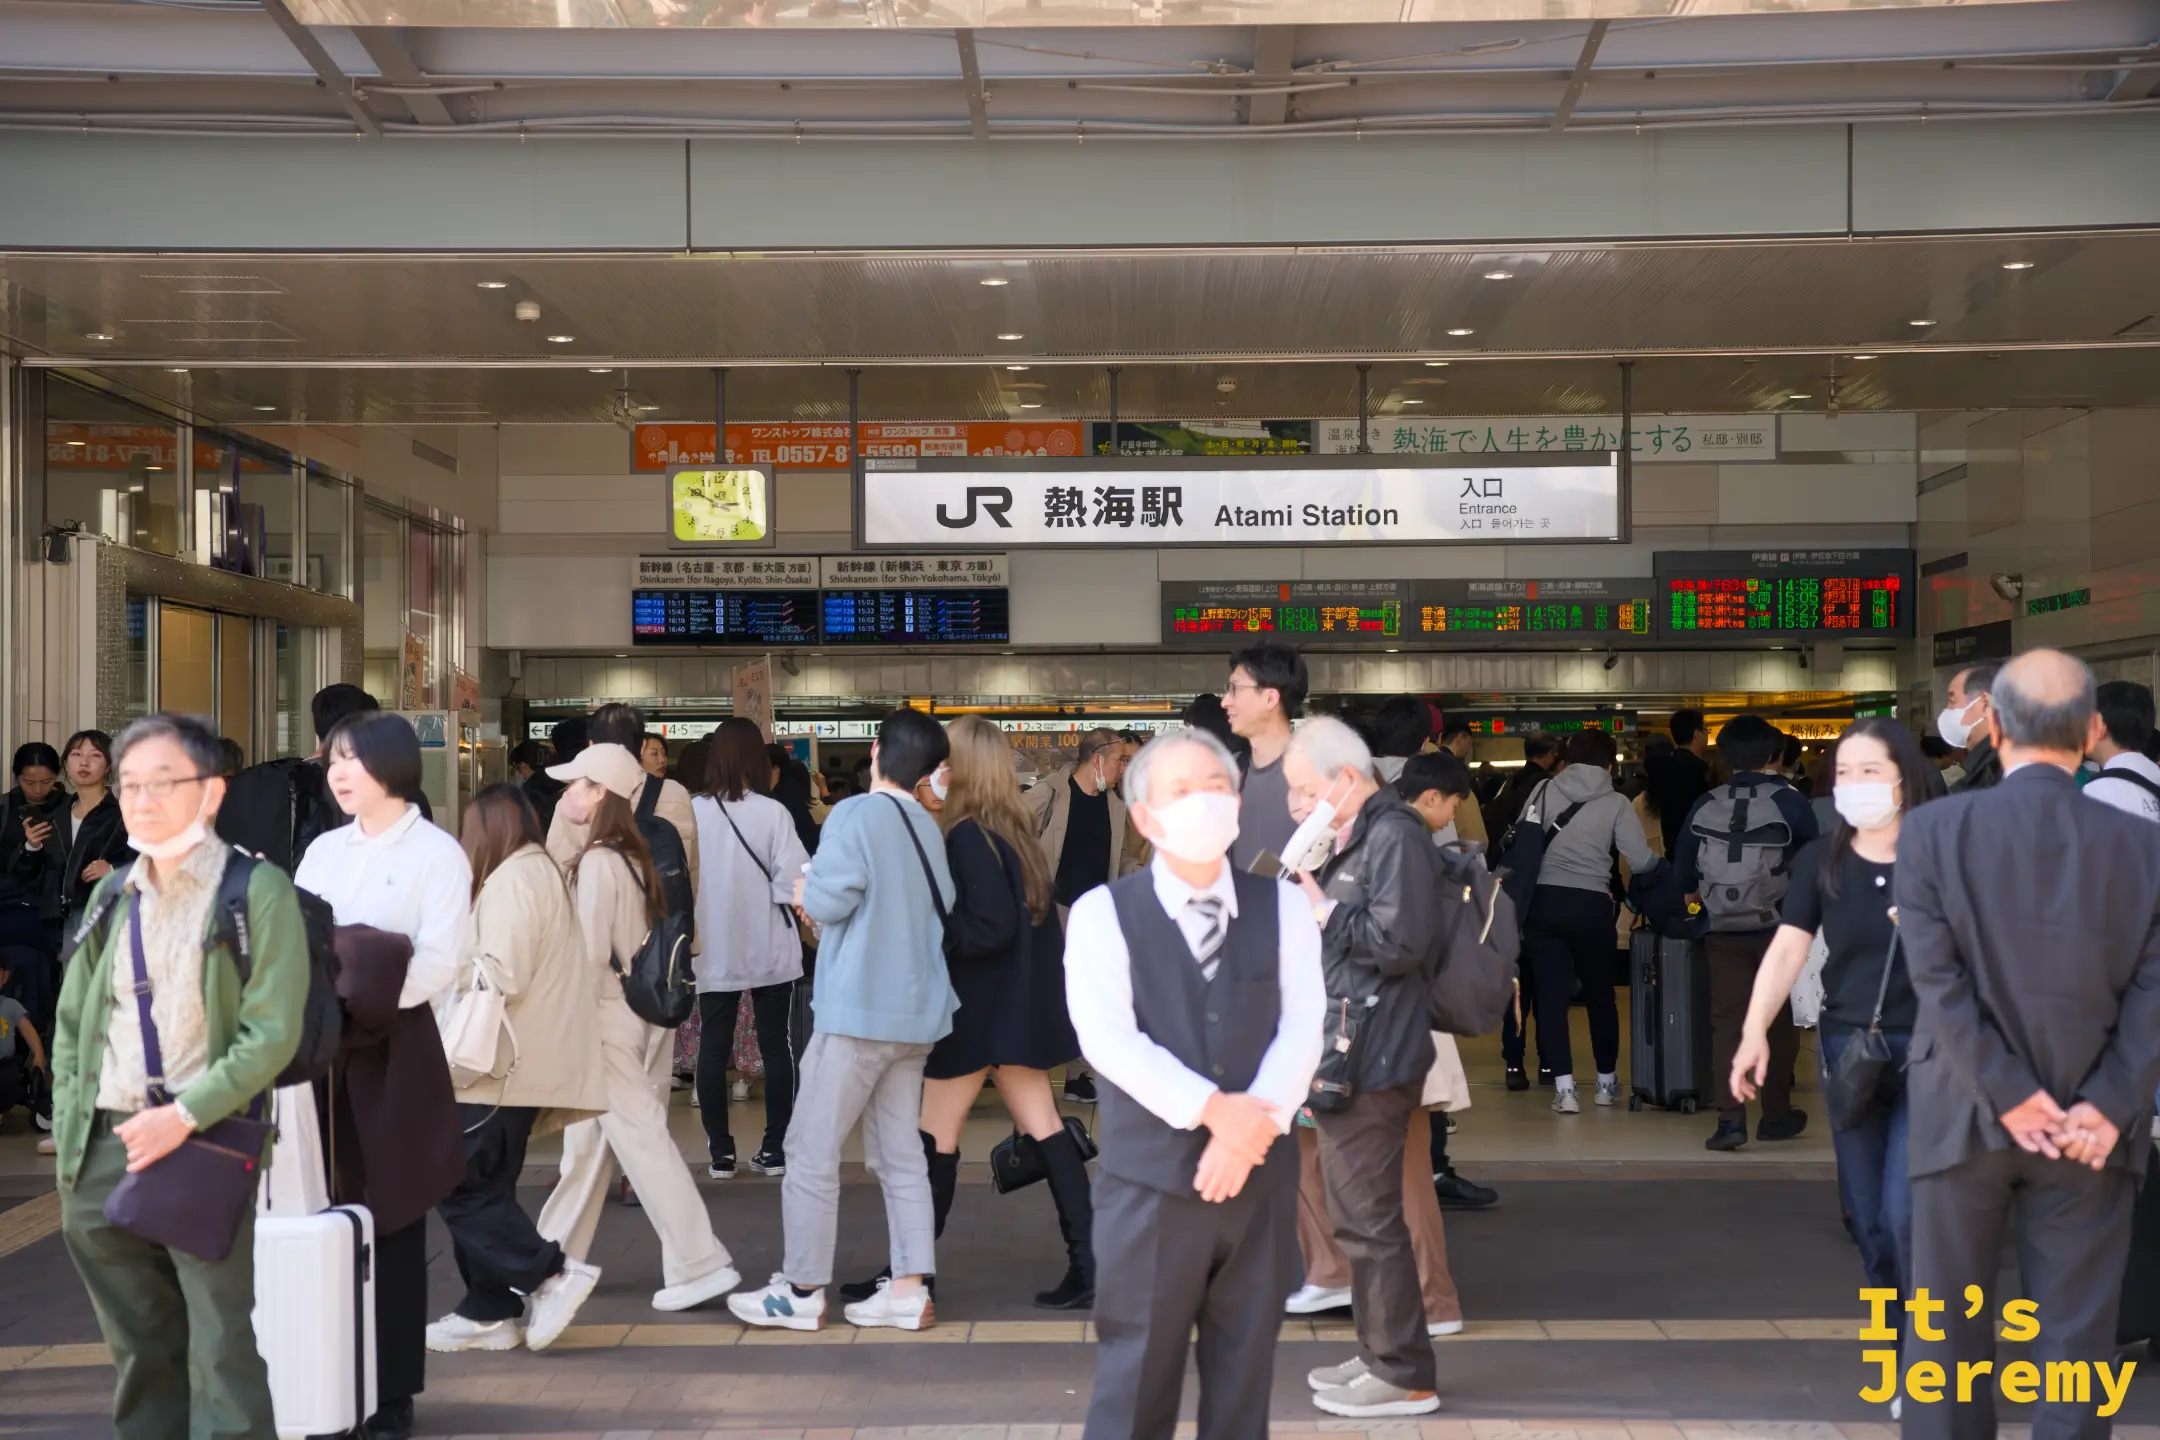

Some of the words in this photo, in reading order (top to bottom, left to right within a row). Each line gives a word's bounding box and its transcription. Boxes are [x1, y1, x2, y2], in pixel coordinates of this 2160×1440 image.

[1702, 433, 1763, 445] 私邸・別邸
[1460, 477, 1503, 498] 入口
[936, 486, 1013, 529] JR
[1044, 485, 1184, 529] 熱海駅
[1214, 504, 1292, 527] Atami
[1302, 503, 1399, 526] Station
[1459, 502, 1518, 515] Entrance
[1460, 519, 1482, 530] 入口
[1490, 518, 1536, 531] 들어가는
[1539, 518, 1552, 531] 곳
[639, 574, 685, 585] Shinkansen
[703, 575, 736, 587] Nagoya,
[829, 574, 879, 583] Shinkansen
[881, 573, 898, 584] (for
[899, 573, 970, 584] Shin-Yokohama,
[1776, 579, 1819, 591] 14:55
[1671, 591, 1696, 604] 普通
[1776, 591, 1819, 604] 15:05
[1174, 608, 1199, 620] 普通
[1278, 608, 1317, 620] 15:01
[1322, 607, 1359, 620] 宇都宮
[1422, 606, 1446, 619] 普通
[1526, 606, 1567, 617] 14:53
[1671, 605, 1696, 617] 普通
[1776, 603, 1819, 616] 15:27
[1278, 620, 1319, 632] 15:08
[1422, 619, 1446, 631] 普通
[1526, 618, 1567, 631] 15:19
[1671, 617, 1696, 630] 普通
[1776, 616, 1819, 629] 15:57
[1057, 733, 1079, 747] 100
